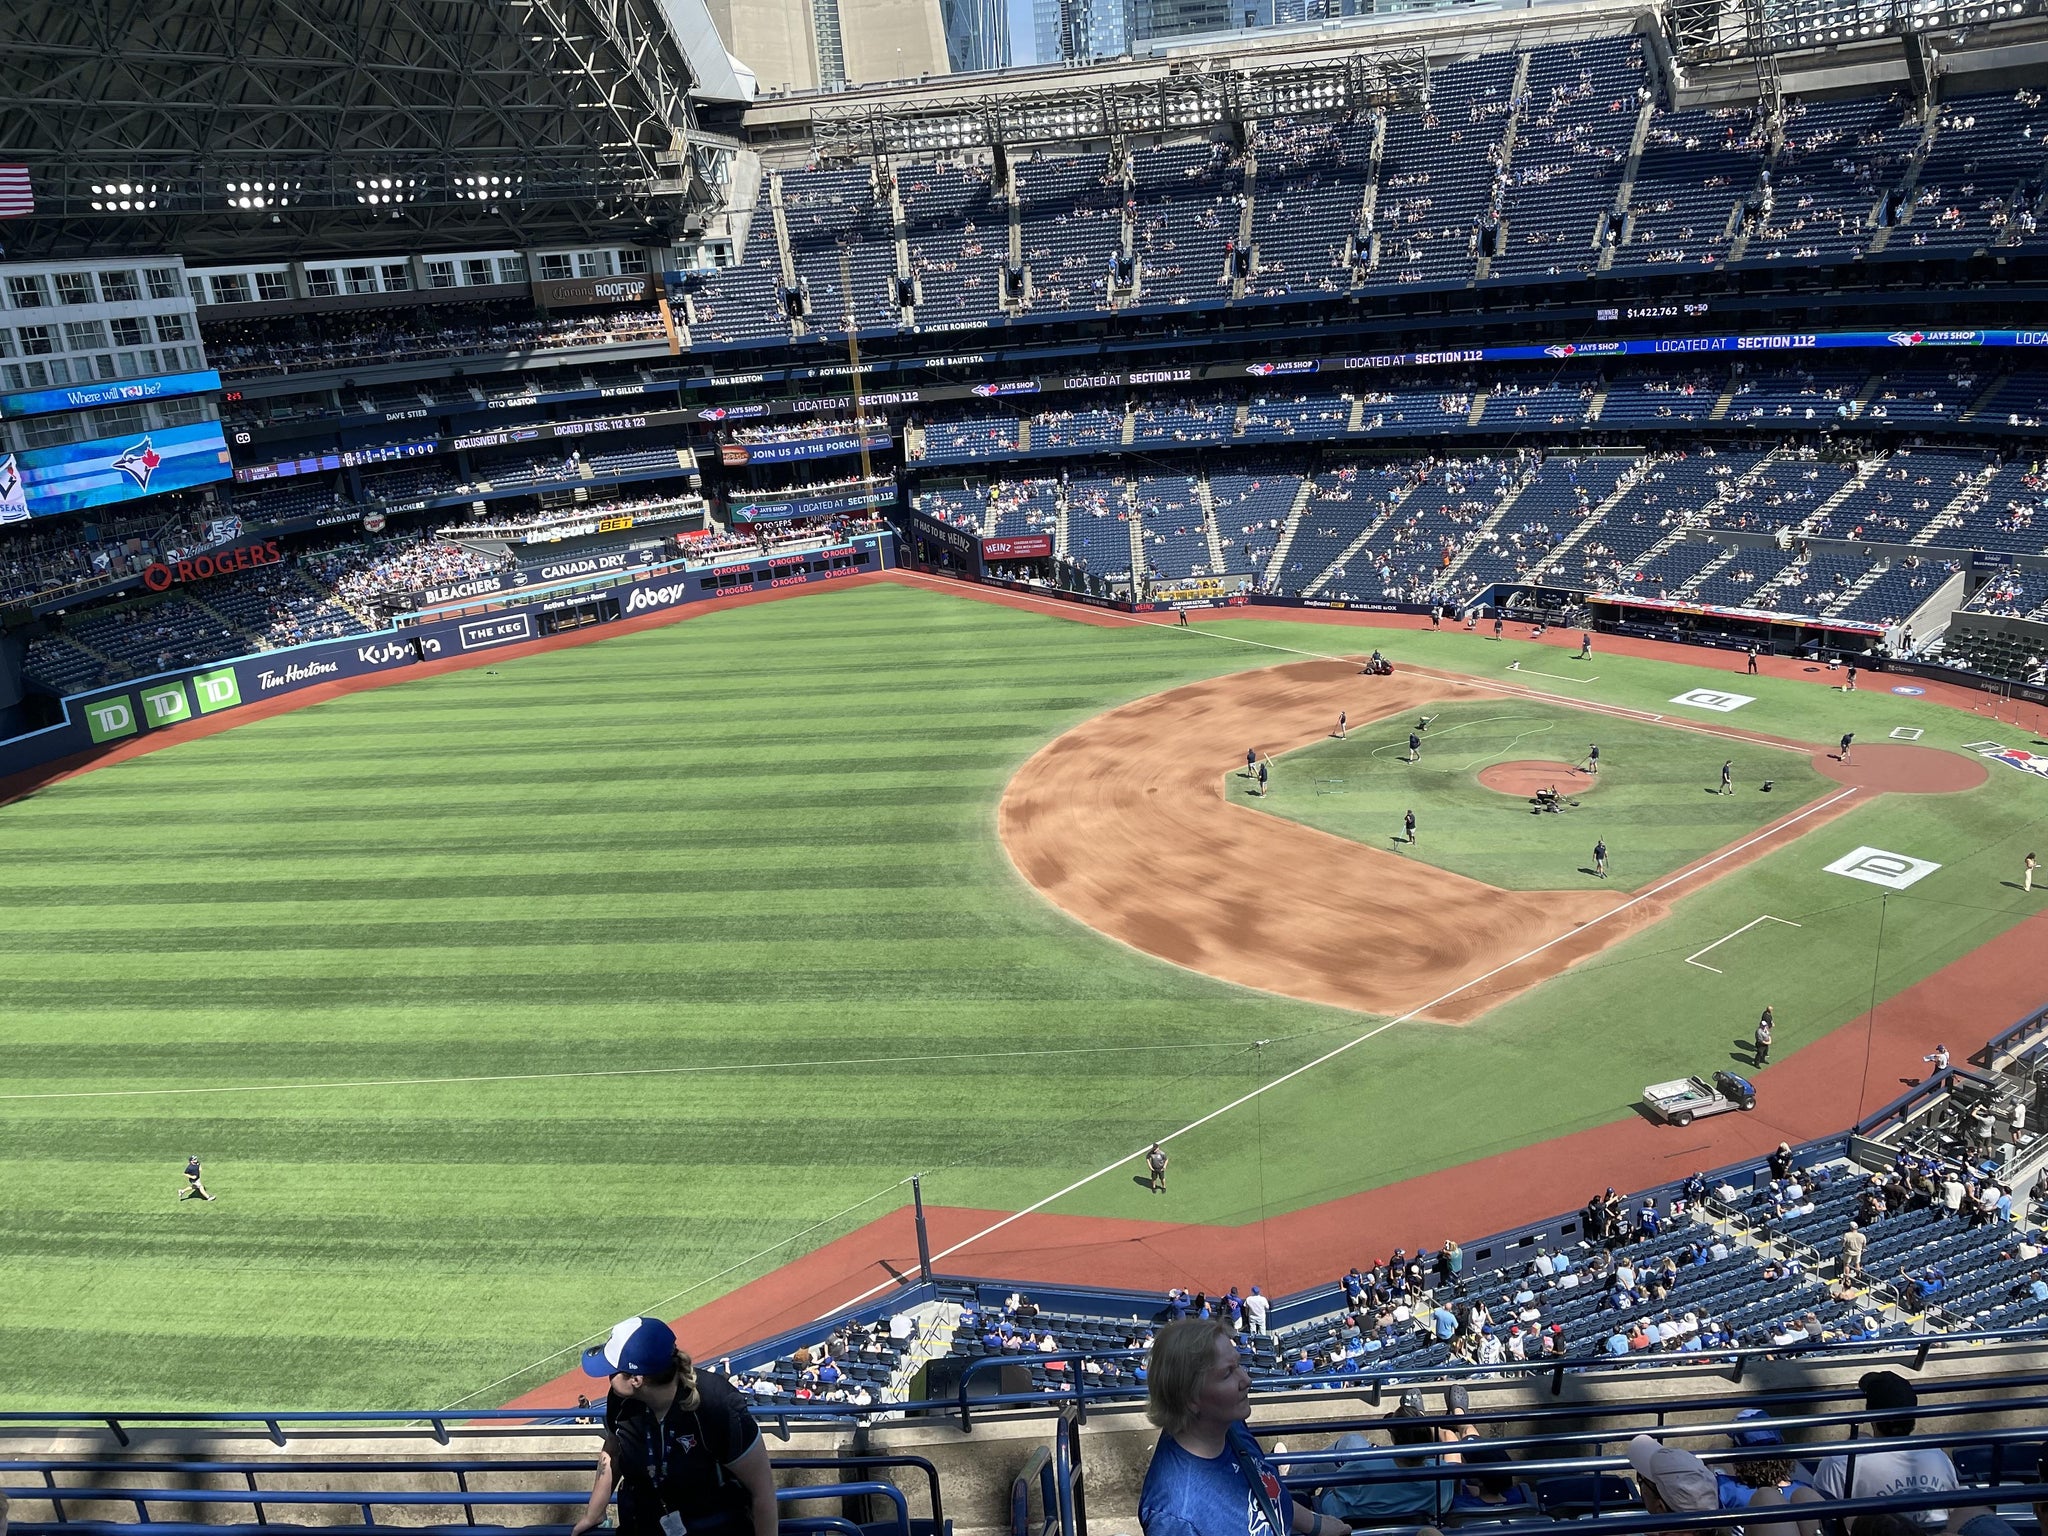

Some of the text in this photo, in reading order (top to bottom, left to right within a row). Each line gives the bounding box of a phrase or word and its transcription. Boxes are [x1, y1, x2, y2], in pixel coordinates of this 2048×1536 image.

[595, 281, 646, 297] ROOFTOP
[924, 321, 988, 332] JACKIE ROBINSON
[1928, 331, 1976, 340] JAYS SHOP
[1655, 336, 1815, 352] LOCATED AT SECTION 112
[947, 355, 984, 366] BAUTISTA
[1276, 361, 1313, 370] JAYS SHOP
[1344, 350, 1483, 369] LOCATED AT SECTION 112
[820, 365, 873, 376] ROY HALLADAY
[710, 375, 763, 386] PAUL BEESTON
[1064, 370, 1191, 389] LOCATED AT SECTION 112
[601, 386, 644, 397] PAT GILLICK
[1000, 381, 1035, 391] JAYS SHOP
[67, 391, 101, 405] Where
[102, 387, 119, 400] will
[143, 382, 162, 395] be?
[488, 397, 537, 409] CITO GASTON
[792, 392, 919, 412] LOCATED AT SECTION 112
[386, 409, 428, 421] DAVE STIEB
[727, 405, 763, 415] JAYS SHOP
[553, 418, 646, 436] LOCATED AT SEC. 112 & 123
[237, 434, 250, 443] CC
[454, 433, 499, 450] EXCLUSIVELY
[499, 433, 508, 444] AT
[752, 450, 776, 459] JOIN
[778, 448, 791, 457] US
[793, 446, 805, 455] AT
[807, 445, 824, 453] THE
[826, 439, 860, 451] PORCH!
[385, 501, 425, 514] BLEACHERS
[798, 492, 894, 513] LOCATED AT SECTION 112
[316, 512, 361, 526] CANADA DRY
[526, 523, 595, 544] theScore
[601, 517, 632, 530] BET
[913, 518, 970, 553] IT HAS TO BE HEINZ
[829, 547, 857, 557] ROGERS
[985, 543, 1012, 554] HEINZ
[177, 541, 281, 583] ROGERS
[775, 555, 804, 567] ROGERS
[541, 560, 598, 579] CANADA
[721, 564, 750, 575] ROGERS
[831, 567, 859, 577] ROGERS
[778, 575, 807, 587] ROGERS
[425, 577, 501, 604] BLEACHERS
[724, 585, 753, 596] ROGERS
[626, 582, 685, 613] Sobeys
[1228, 597, 1249, 606] HEINZ
[543, 601, 565, 611] Active
[1134, 603, 1155, 612] HEINZ
[469, 622, 521, 640] THE KEG
[257, 661, 338, 690] Tim Hortons
[199, 676, 234, 703] TD
[147, 690, 183, 718] TD
[91, 704, 129, 733] TD
[1619, 1298, 1631, 1309] 30
